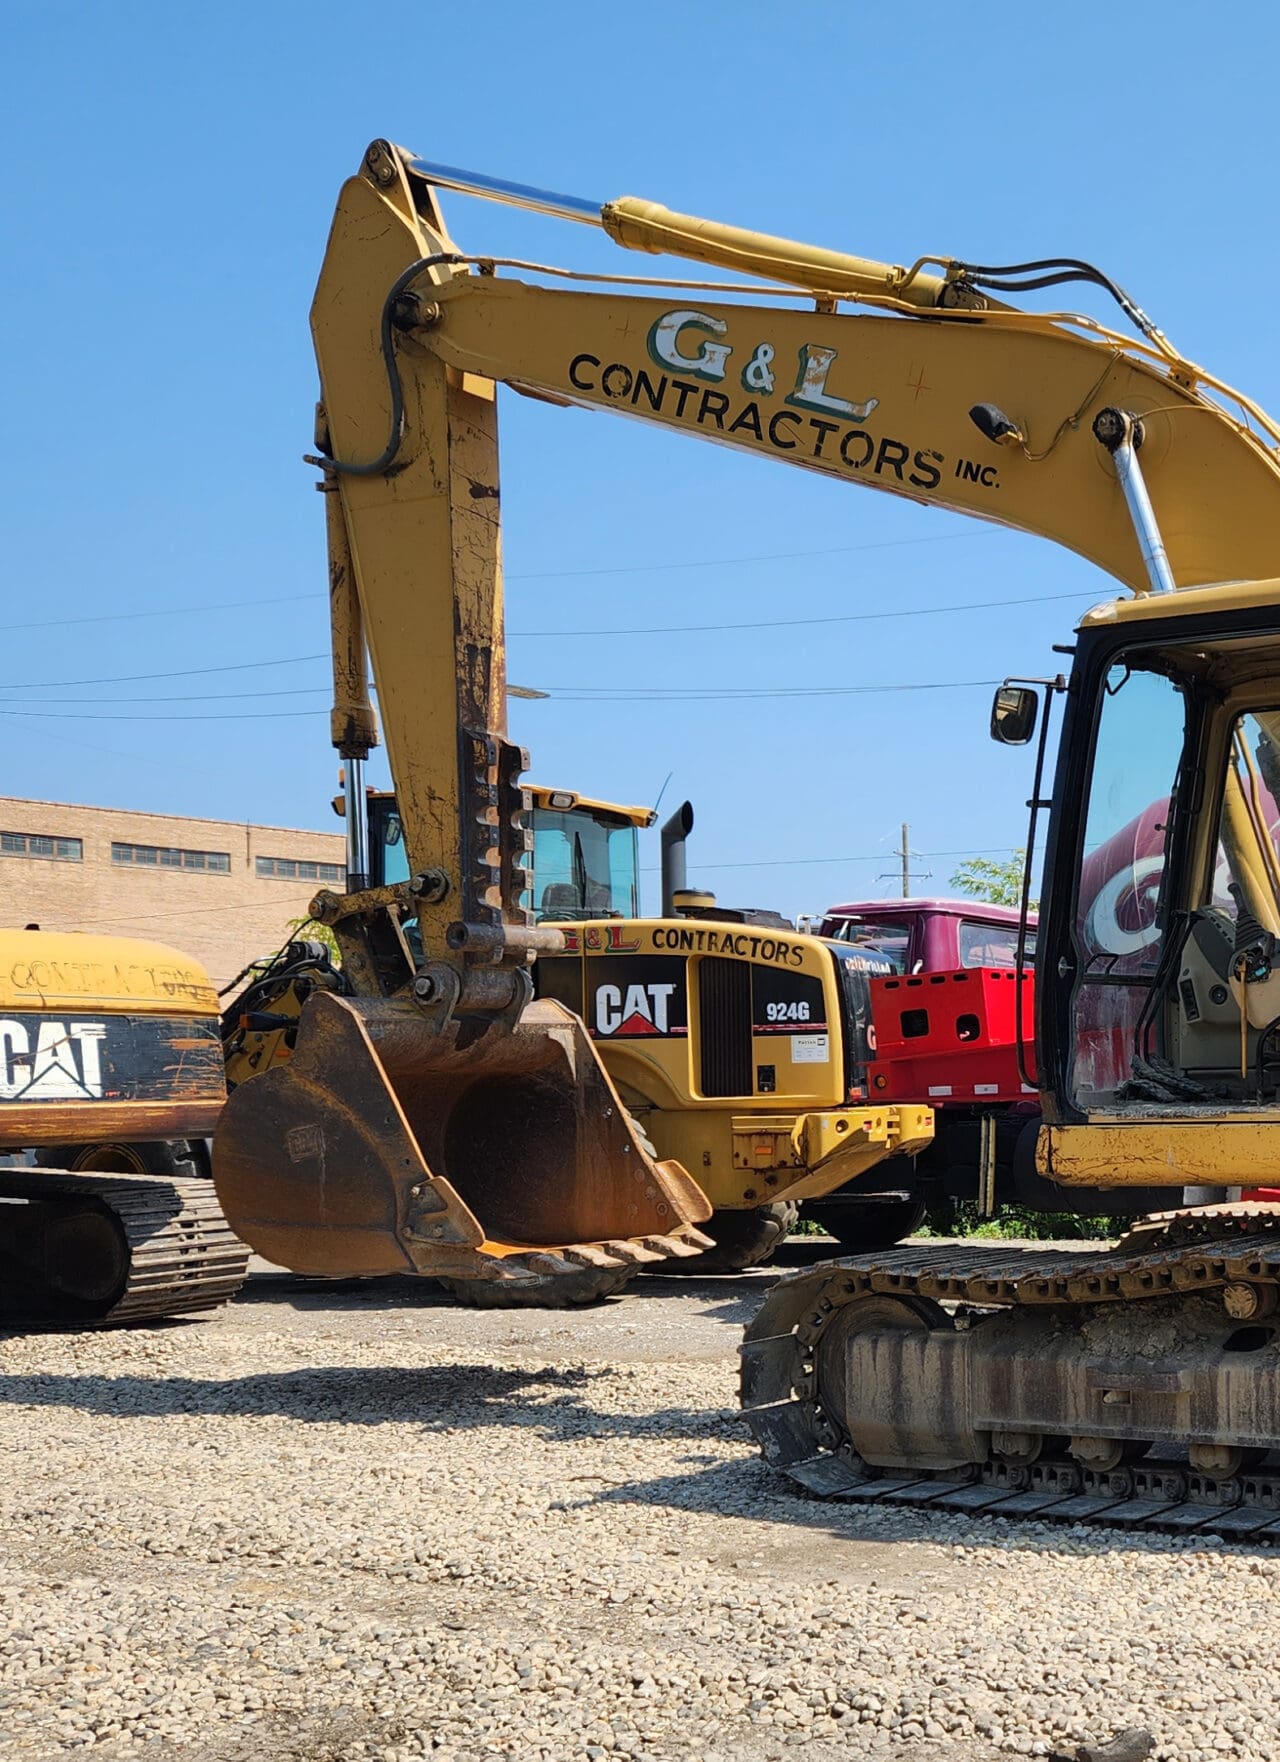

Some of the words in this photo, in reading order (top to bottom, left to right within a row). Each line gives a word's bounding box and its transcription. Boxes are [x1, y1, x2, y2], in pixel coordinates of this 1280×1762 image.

[647, 309, 733, 383] G
[741, 342, 776, 397] &
[784, 342, 880, 424] L
[568, 353, 945, 490] CONTRACTORS
[954, 459, 1000, 489] INC.
[586, 927, 602, 950] &
[605, 924, 642, 953] L
[652, 928, 805, 966] CONTRACTORS
[596, 984, 674, 1034] CAT
[766, 1001, 810, 1022] 924G
[0, 1019, 107, 1100] CAT
